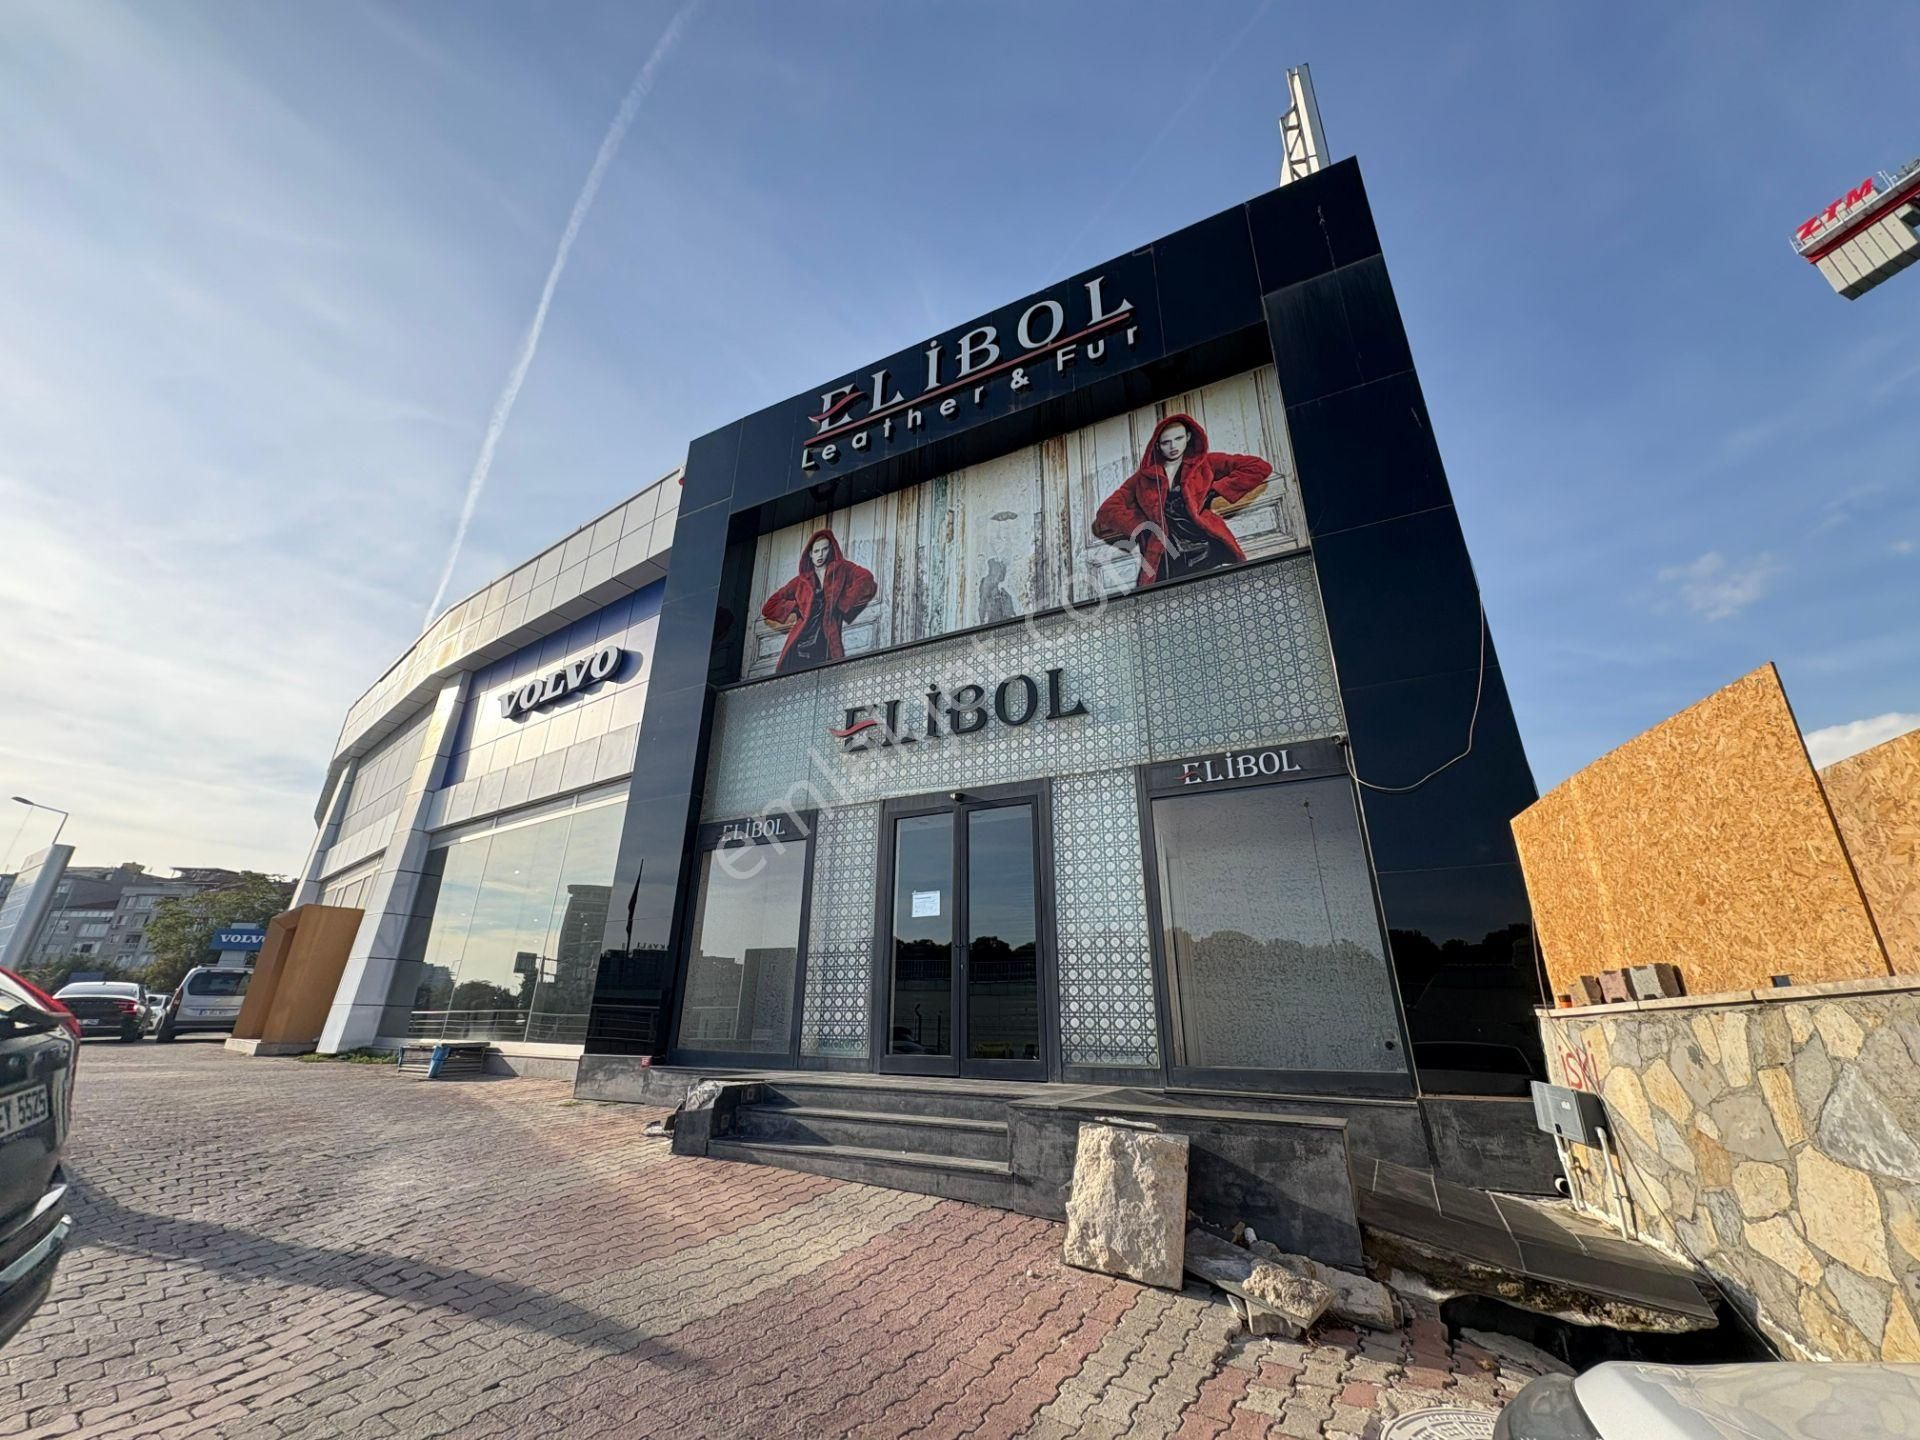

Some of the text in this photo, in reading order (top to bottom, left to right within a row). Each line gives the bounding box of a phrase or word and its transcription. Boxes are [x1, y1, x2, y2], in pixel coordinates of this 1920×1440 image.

[1796, 177, 1873, 240] ZTM
[809, 276, 1135, 434] ELİBOL
[801, 325, 1137, 469] Leather & Fur
[498, 646, 622, 718] VOLVO
[1176, 750, 1301, 785] ELİBOL
[719, 818, 786, 842] ELİBOL
